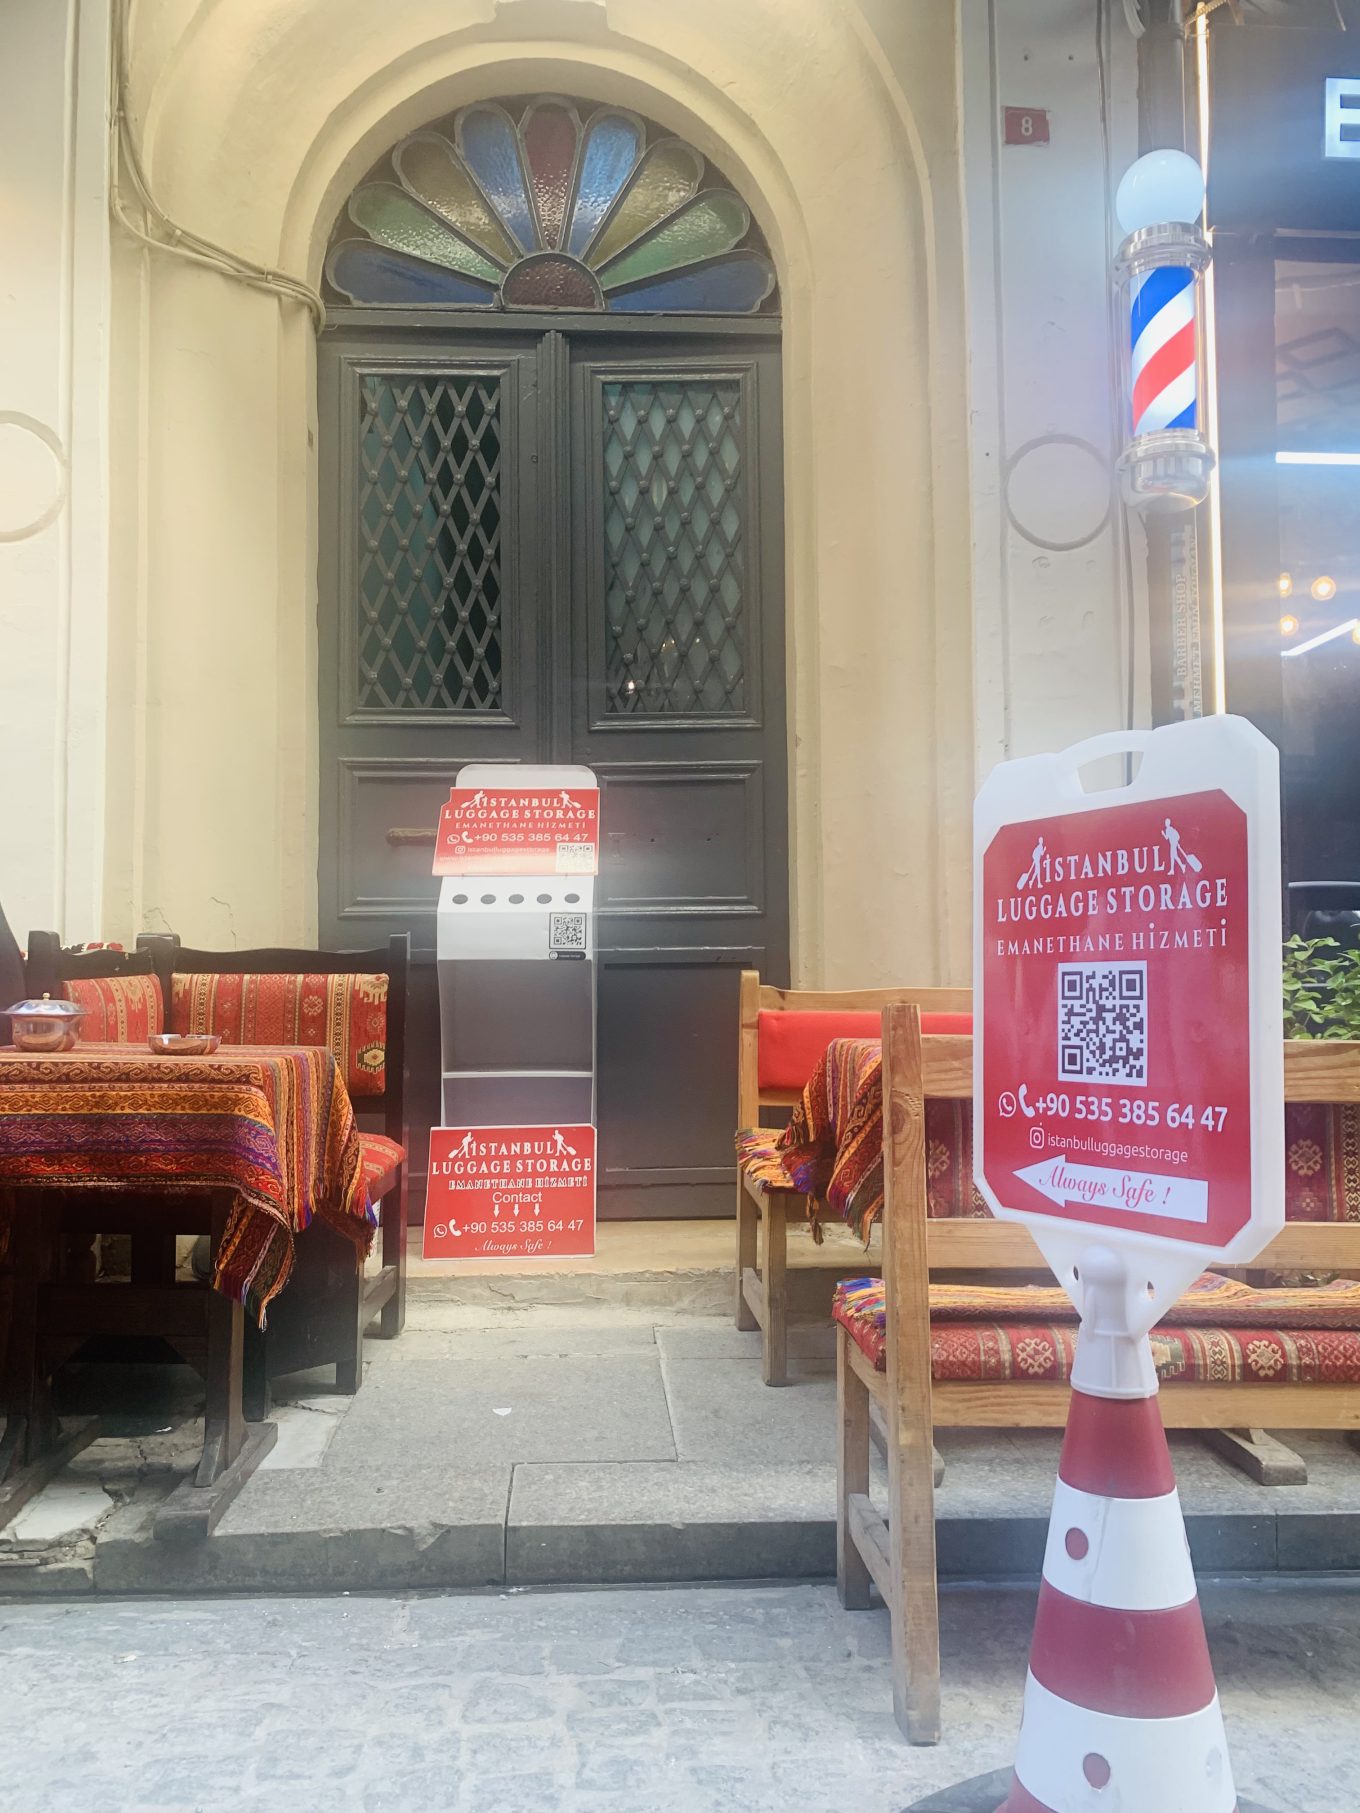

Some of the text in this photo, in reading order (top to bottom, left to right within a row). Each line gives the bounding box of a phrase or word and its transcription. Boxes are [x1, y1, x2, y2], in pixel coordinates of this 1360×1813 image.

[1021, 116, 1033, 136] 8
[1176, 574, 1187, 676] BARBER SHOP
[445, 809, 595, 819] LUGGAGE STORAGE
[474, 833, 589, 842] +90 535 385 64 47
[1043, 845, 1166, 883] İSTANBUL
[997, 878, 1228, 922] LUGGAGE STORAGE
[997, 918, 1227, 956] EMANETHANE HİZMETİ
[1035, 1092, 1228, 1133] +90 535 385 64 47
[1047, 1132, 1188, 1164] istanbulluggagestorage
[432, 1158, 592, 1175] LUGGAGE STORAGE
[448, 1178, 533, 1190] EMANETHANE
[1039, 1165, 1108, 1201] Always
[1112, 1174, 1155, 1208] Safe
[492, 1191, 543, 1203] Contact
[463, 1219, 584, 1234] +90 535 385 64 47
[475, 1240, 518, 1255] Always
[520, 1239, 544, 1254] Safe
